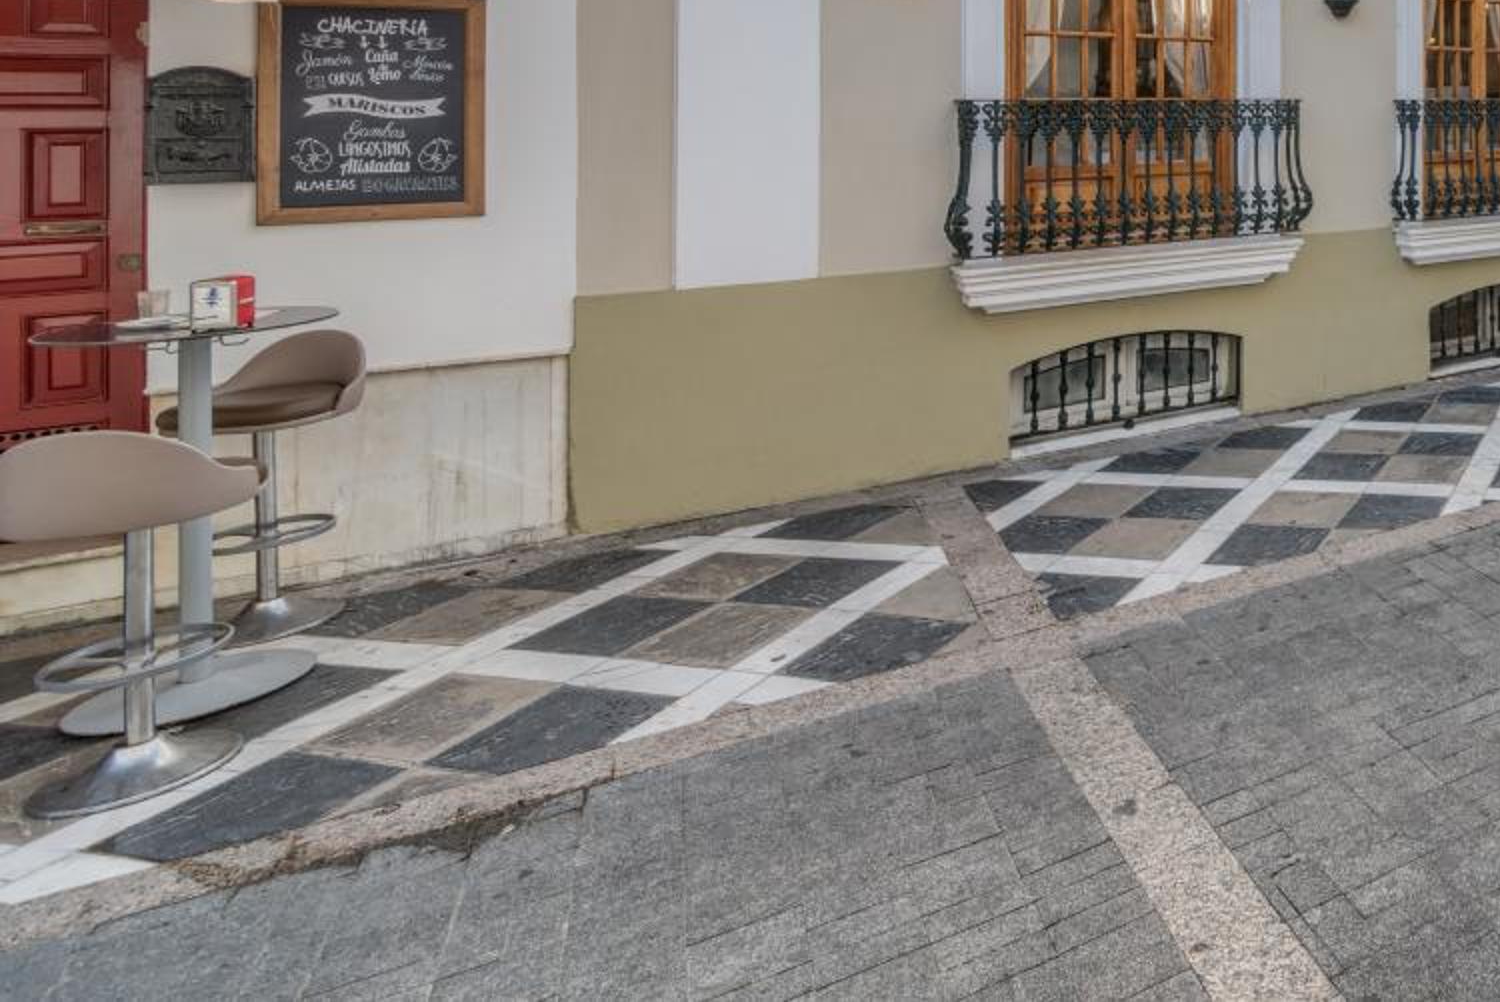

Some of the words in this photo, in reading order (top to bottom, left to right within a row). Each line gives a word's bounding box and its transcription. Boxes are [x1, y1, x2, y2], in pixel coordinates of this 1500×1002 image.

[365, 49, 399, 63] Caña
[367, 67, 402, 85] Lomo
[328, 97, 426, 115] MARISCOS
[343, 119, 406, 141] Gambas
[294, 178, 356, 193] ALMEJAS
